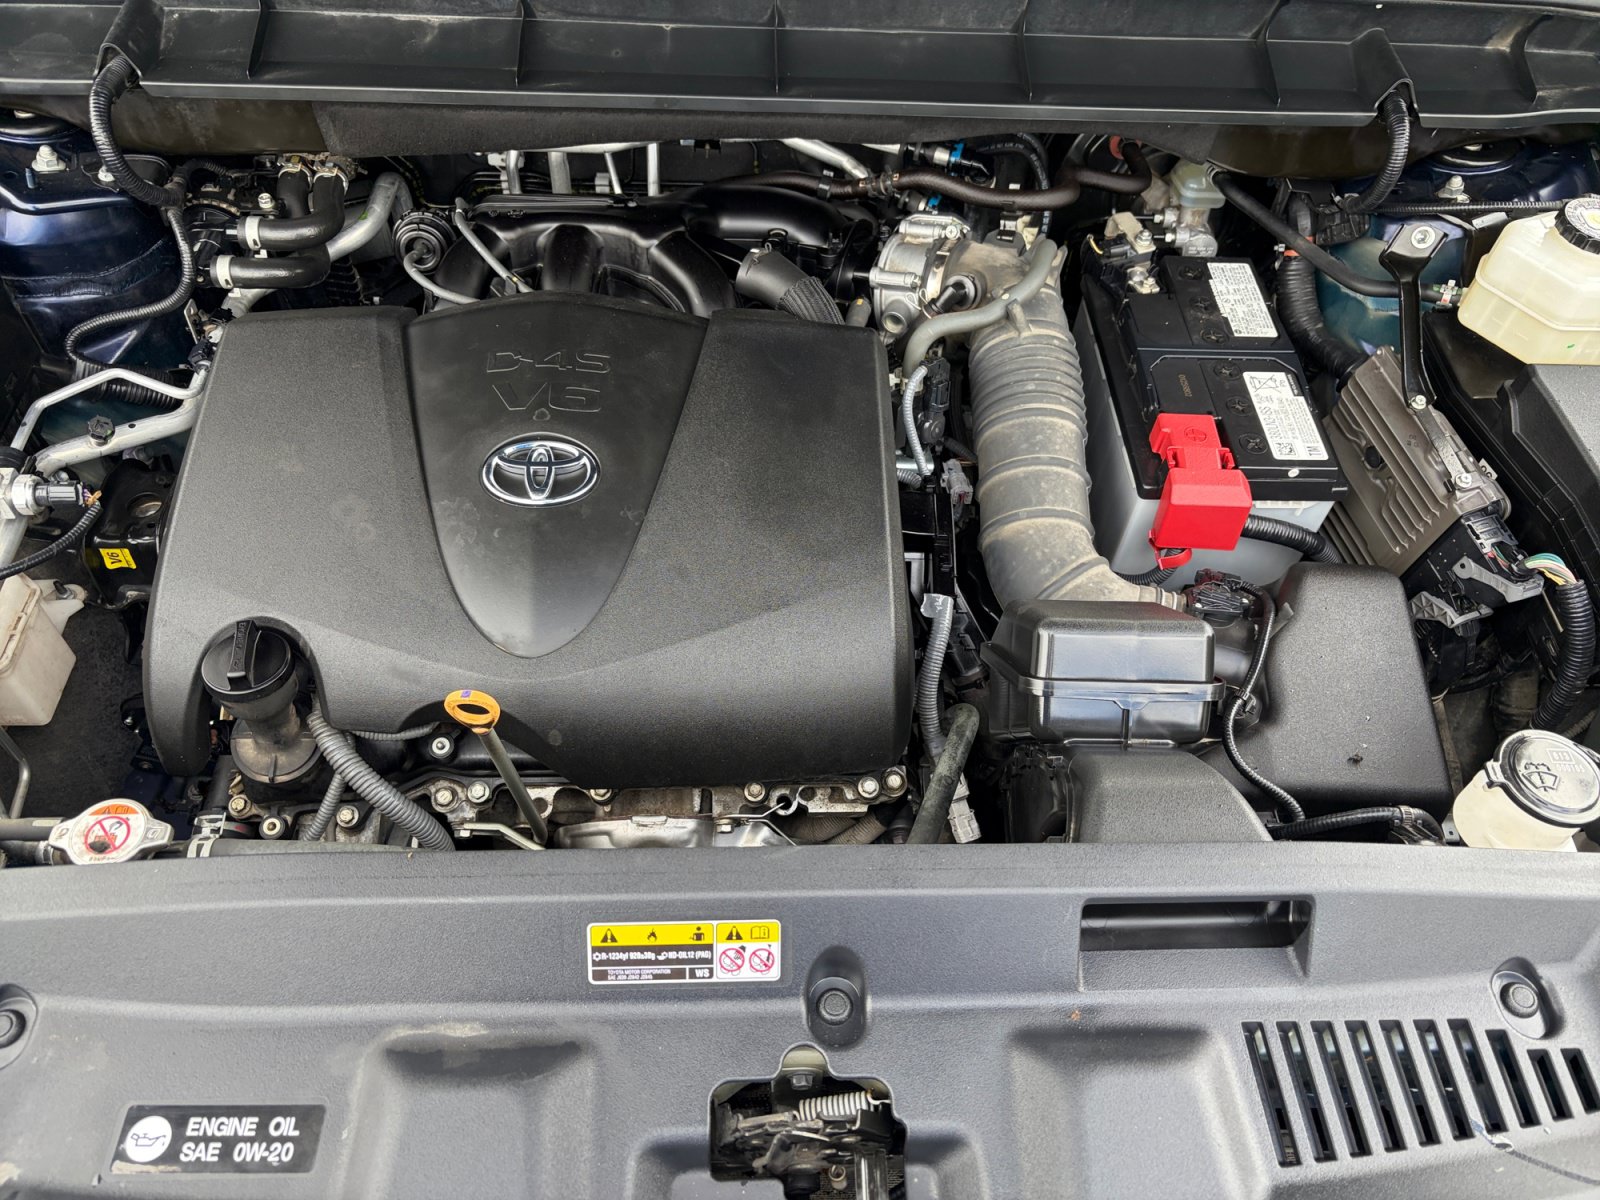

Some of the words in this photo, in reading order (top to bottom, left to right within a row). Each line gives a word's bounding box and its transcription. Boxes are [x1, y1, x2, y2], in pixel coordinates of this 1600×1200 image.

[487, 351, 611, 374] D-4S
[492, 382, 601, 412] V6
[186, 1116, 260, 1137] ENGINE
[268, 1116, 300, 1137] OIL
[179, 1142, 223, 1163] SAE
[232, 1142, 295, 1163] 0W-20
